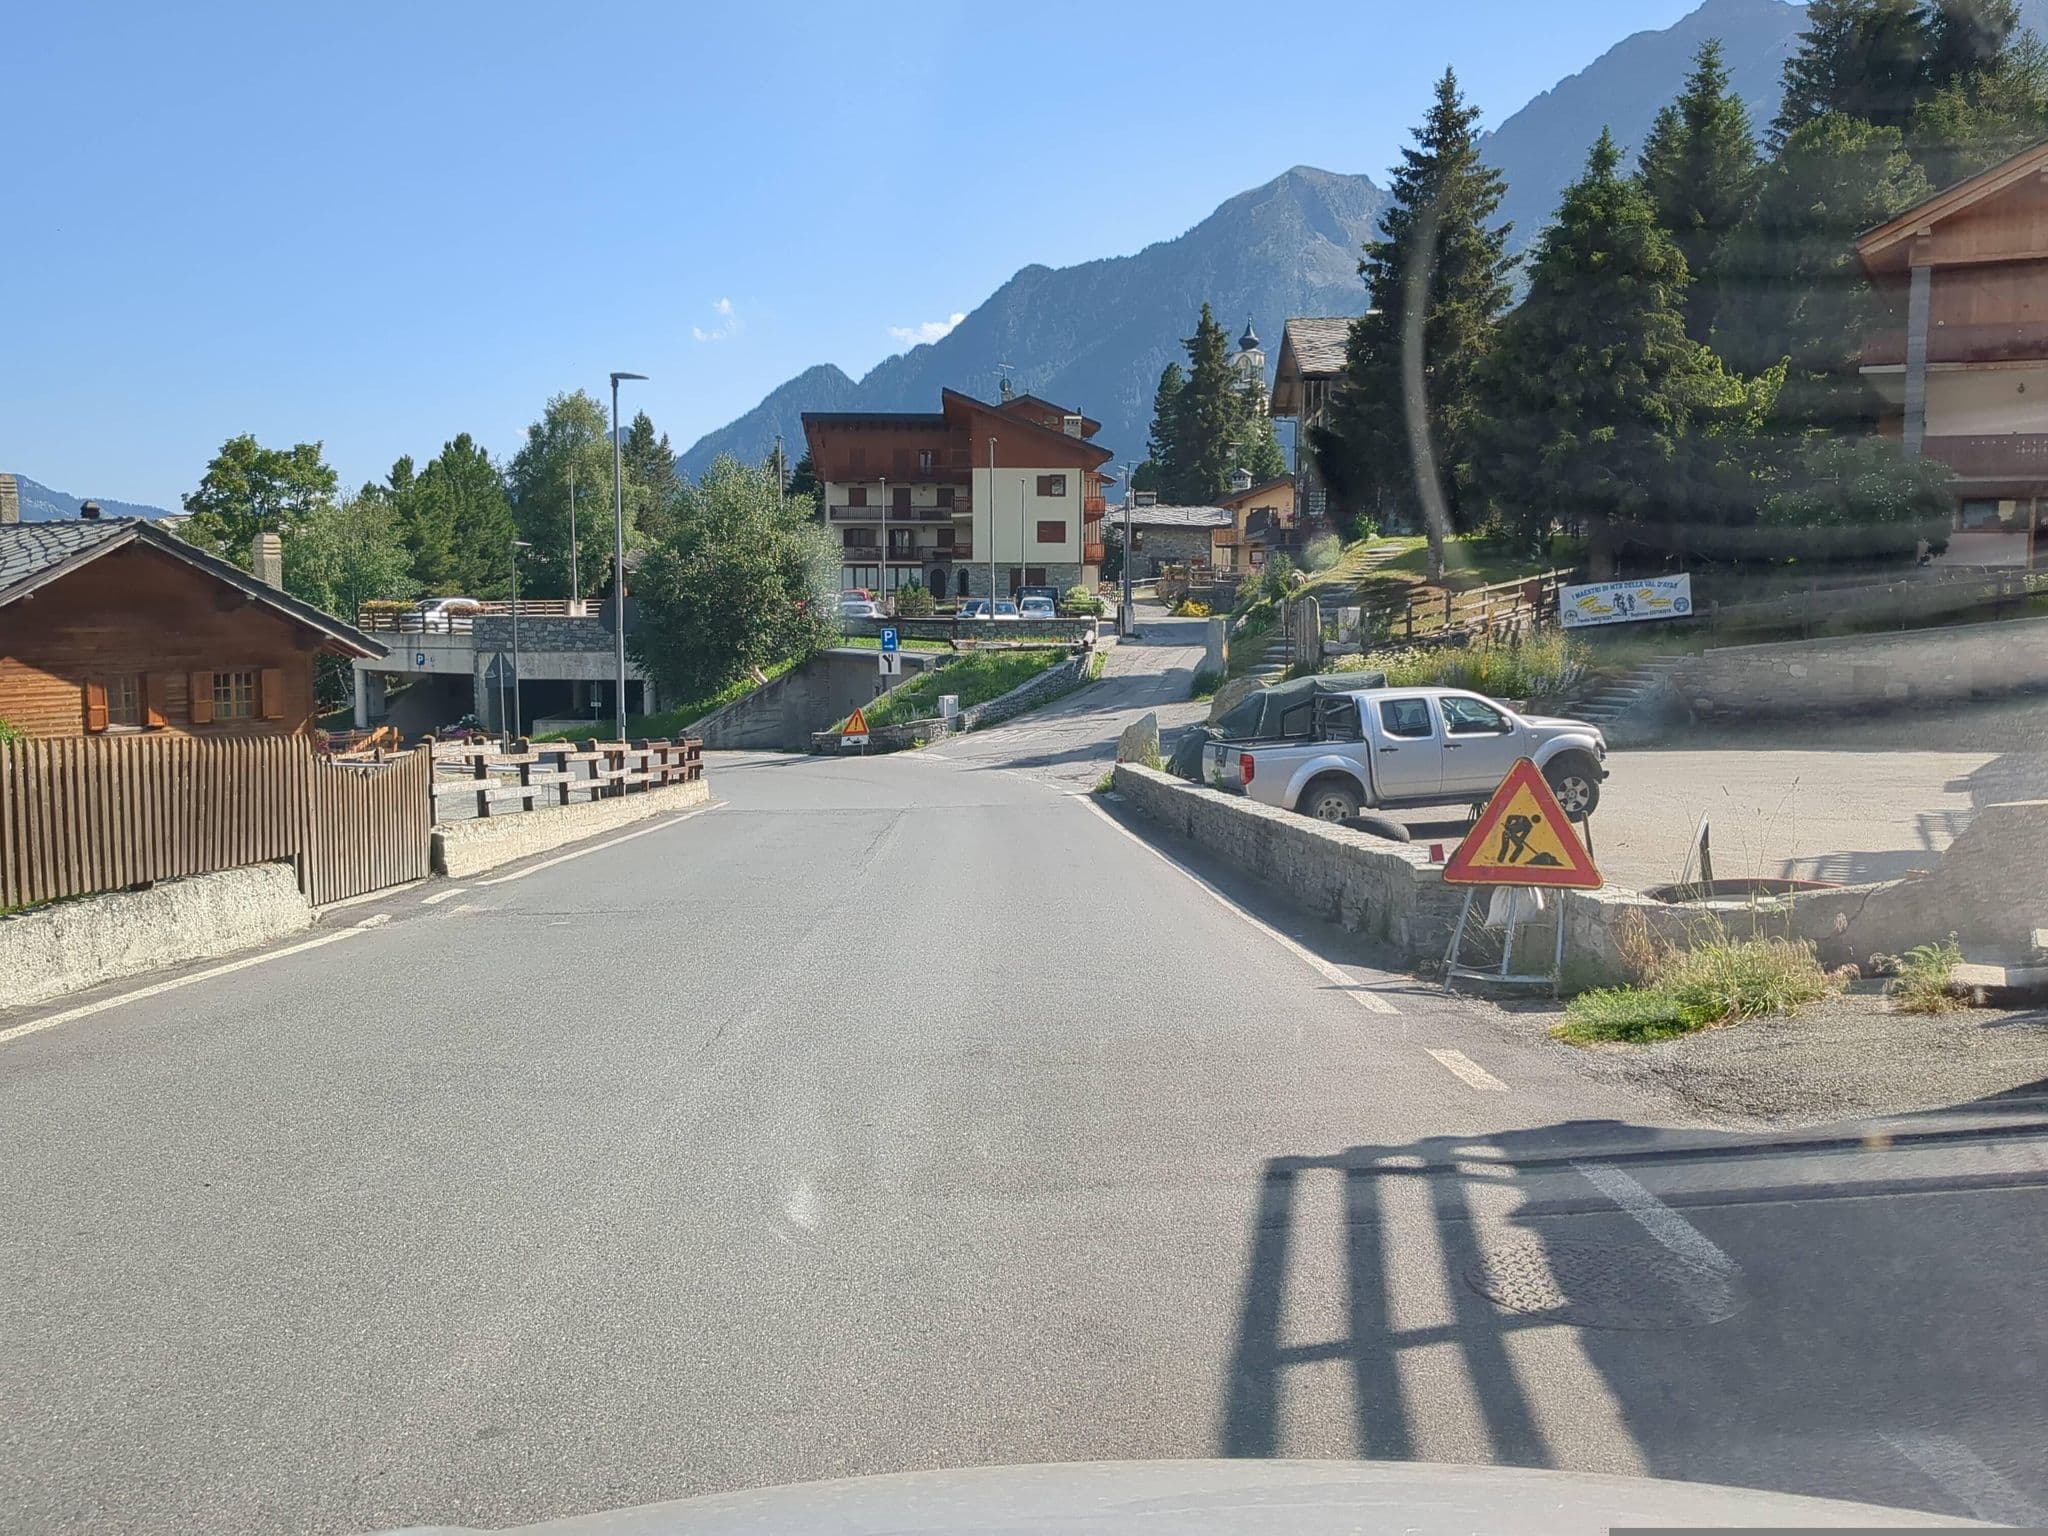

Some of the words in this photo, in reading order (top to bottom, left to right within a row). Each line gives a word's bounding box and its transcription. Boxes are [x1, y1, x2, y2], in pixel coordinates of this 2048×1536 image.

[1575, 587, 1602, 598] MAESTRI
[1624, 581, 1644, 589] DELLA
[1645, 580, 1656, 588] VAL
[884, 631, 893, 642] P
[418, 655, 424, 664] P
